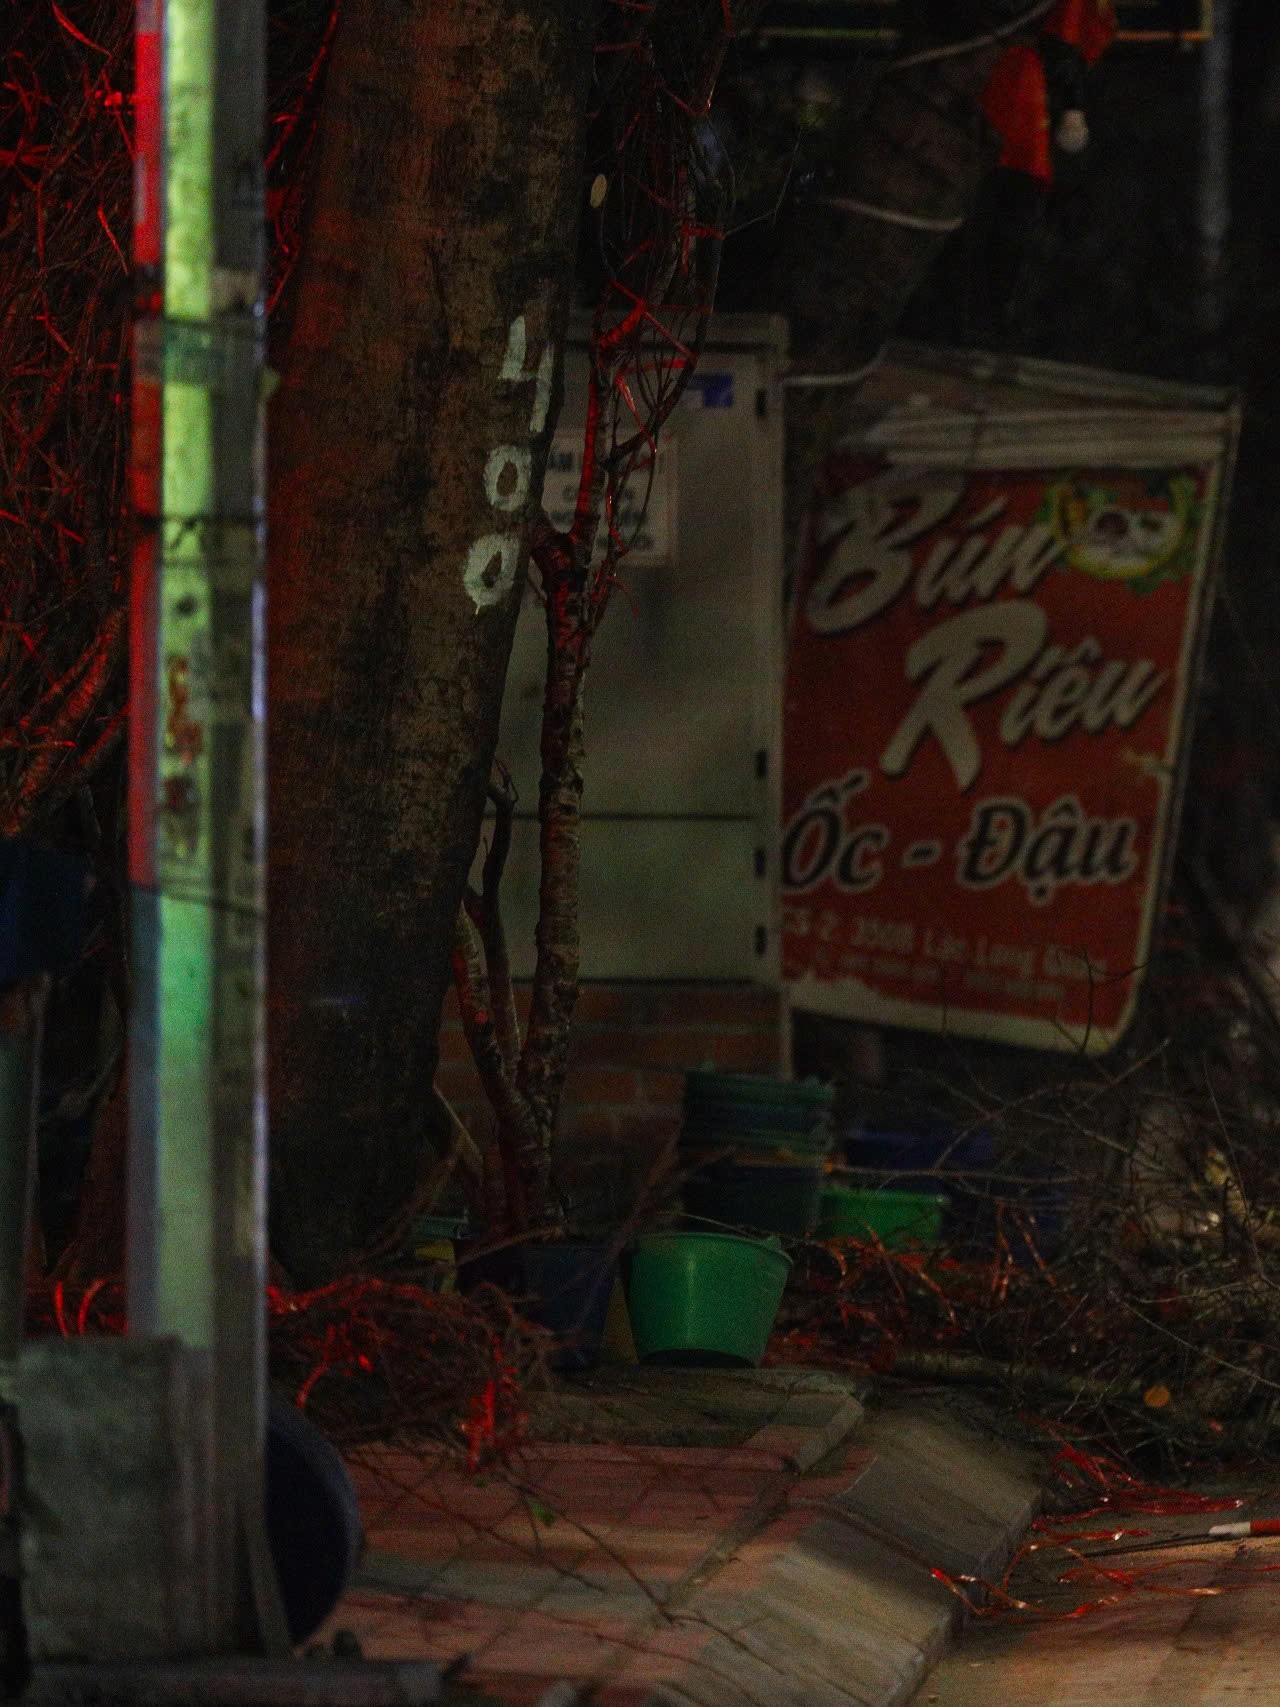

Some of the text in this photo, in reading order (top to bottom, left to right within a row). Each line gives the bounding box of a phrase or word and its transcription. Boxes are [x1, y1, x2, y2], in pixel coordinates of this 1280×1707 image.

[805, 470, 1064, 637] Bún
[878, 598, 1168, 794] Riêu
[782, 768, 890, 893] Ốc
[955, 794, 1140, 906] Đậu
